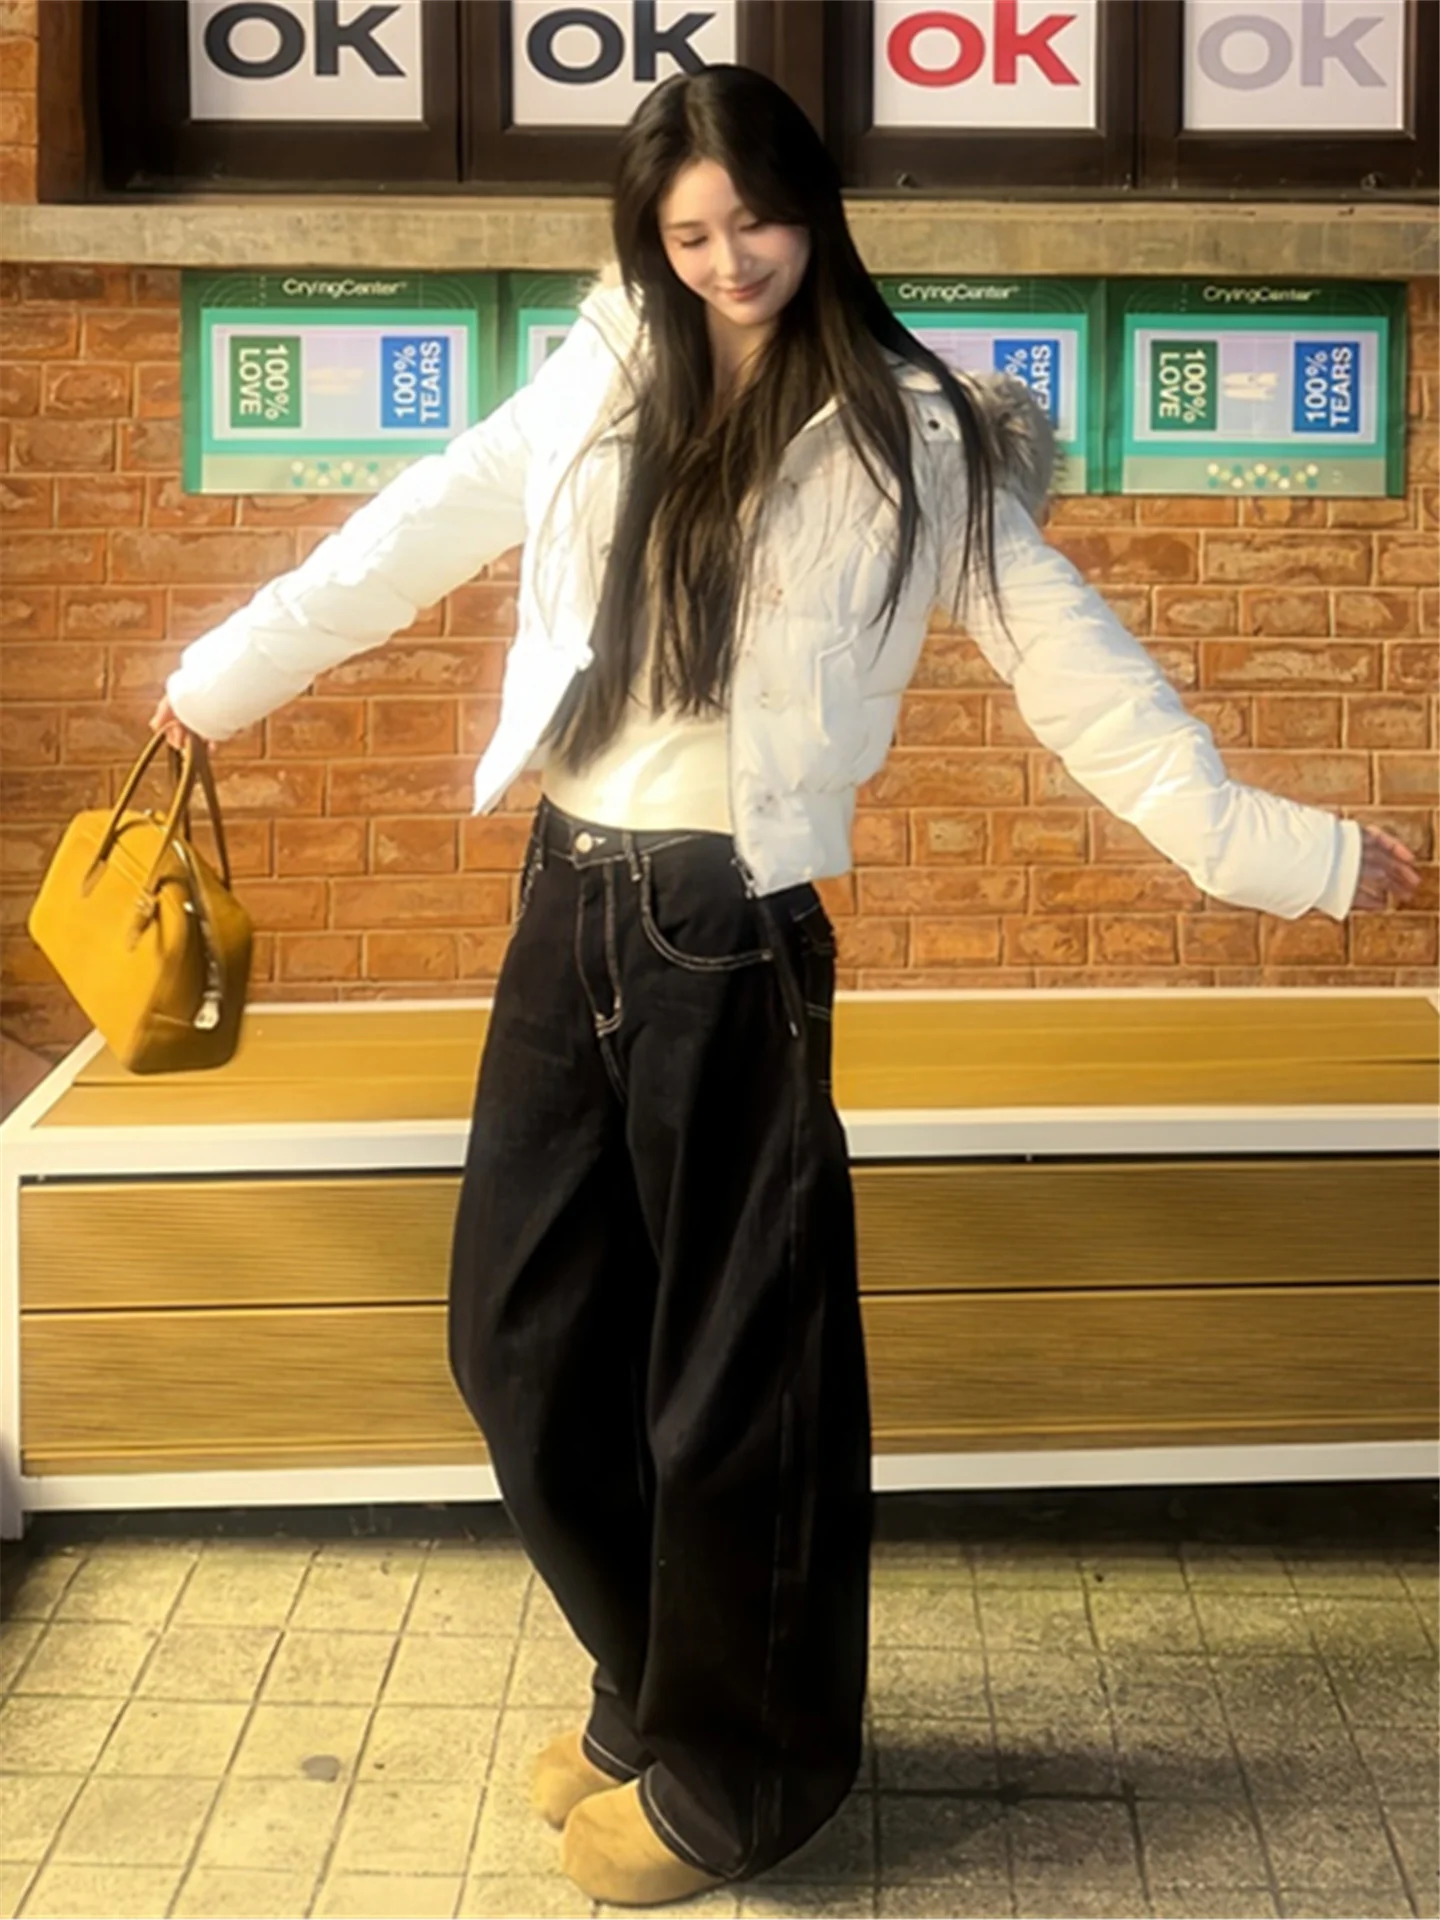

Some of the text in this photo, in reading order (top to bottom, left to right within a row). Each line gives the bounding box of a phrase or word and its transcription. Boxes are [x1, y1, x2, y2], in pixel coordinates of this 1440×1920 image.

[238, 347, 262, 415] LOVE
[264, 344, 290, 421] 100%
[393, 345, 417, 418] 100%
[420, 340, 442, 423] TEARS
[1030, 344, 1052, 412] EARS
[1159, 352, 1182, 418] LOVE
[1182, 347, 1208, 424] 100%
[1304, 349, 1329, 423] 100%
[1329, 346, 1353, 428] TEARS
